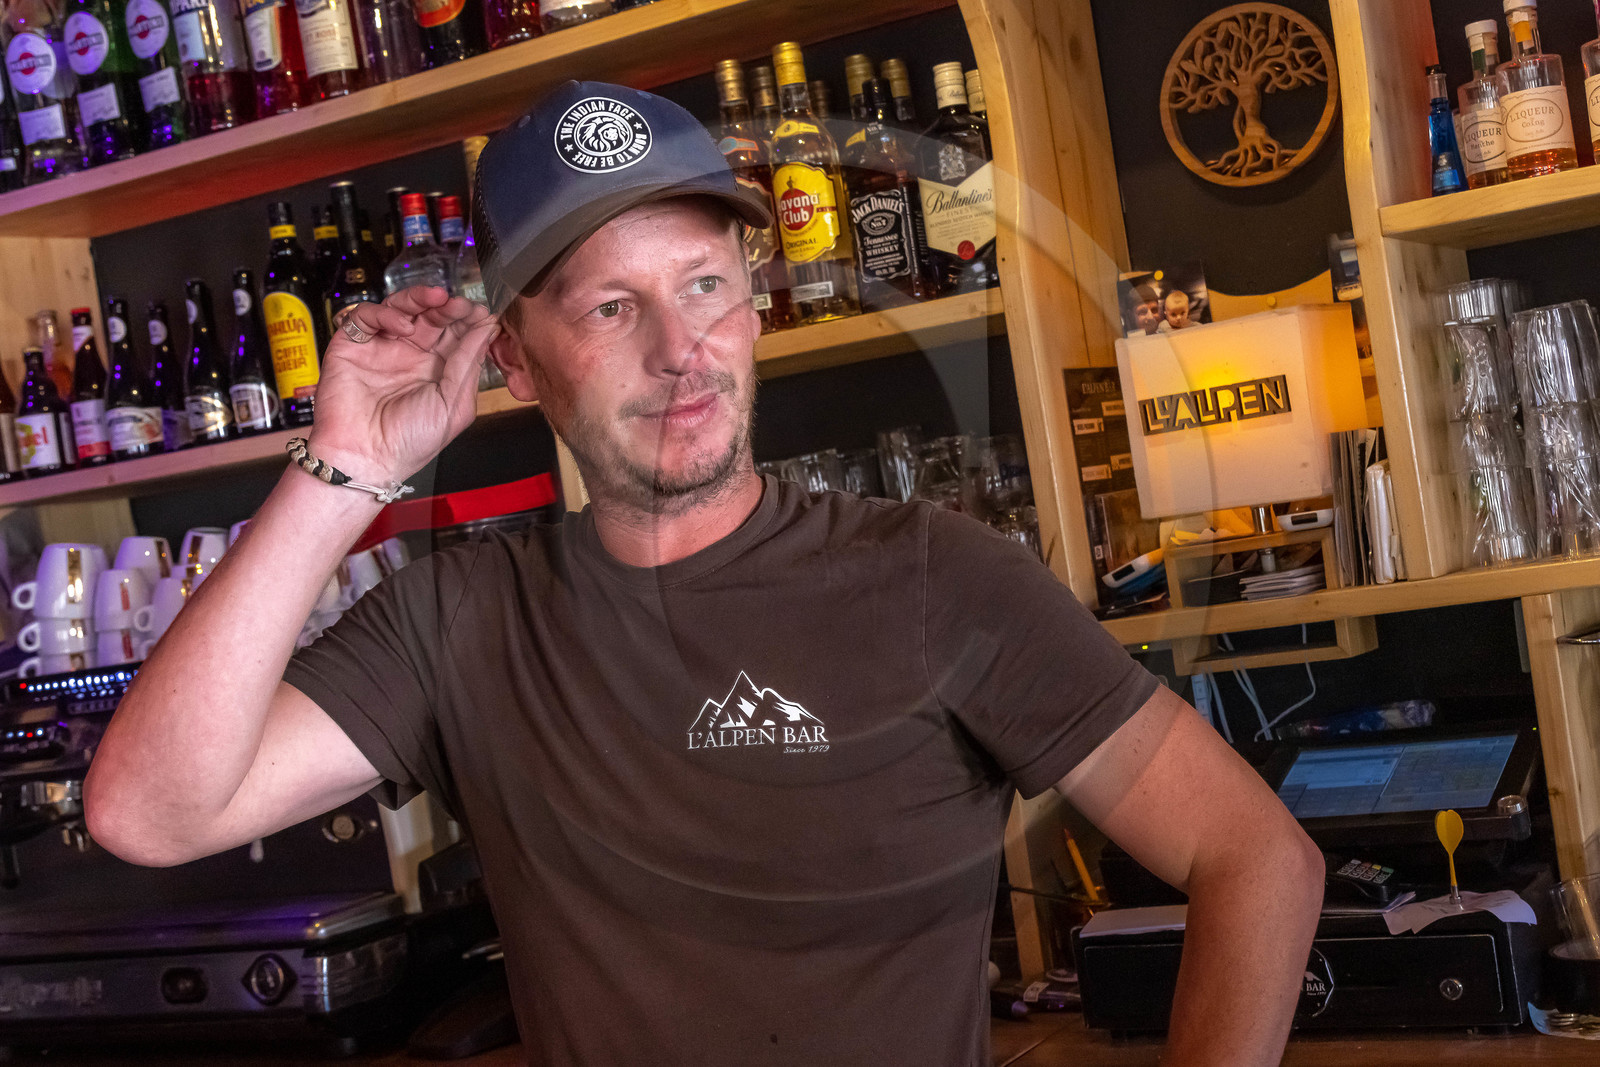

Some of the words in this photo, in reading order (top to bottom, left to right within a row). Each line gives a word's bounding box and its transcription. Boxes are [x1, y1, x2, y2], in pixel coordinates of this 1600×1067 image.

[560, 121, 575, 141] THE
[568, 100, 605, 122] INDIAN
[608, 102, 635, 121] FACE
[1509, 106, 1556, 123] LIQUEUR
[1465, 127, 1502, 144] LIQUEUR
[627, 133, 648, 156] BORN
[571, 151, 598, 168] FREE
[600, 156, 615, 168] BE
[616, 151, 633, 164] TO
[778, 193, 820, 211] avana
[926, 187, 993, 217] Ballantine's
[782, 207, 810, 226] Club
[851, 201, 871, 224] JACK
[865, 244, 900, 257] WHISKEY
[1140, 376, 1290, 435] L'ALPEN
[687, 726, 777, 750] L'ALPEN
[782, 724, 830, 744] BAR
[782, 745, 806, 754] Since
[807, 744, 831, 754] 1979
[1306, 982, 1327, 992] BAR
